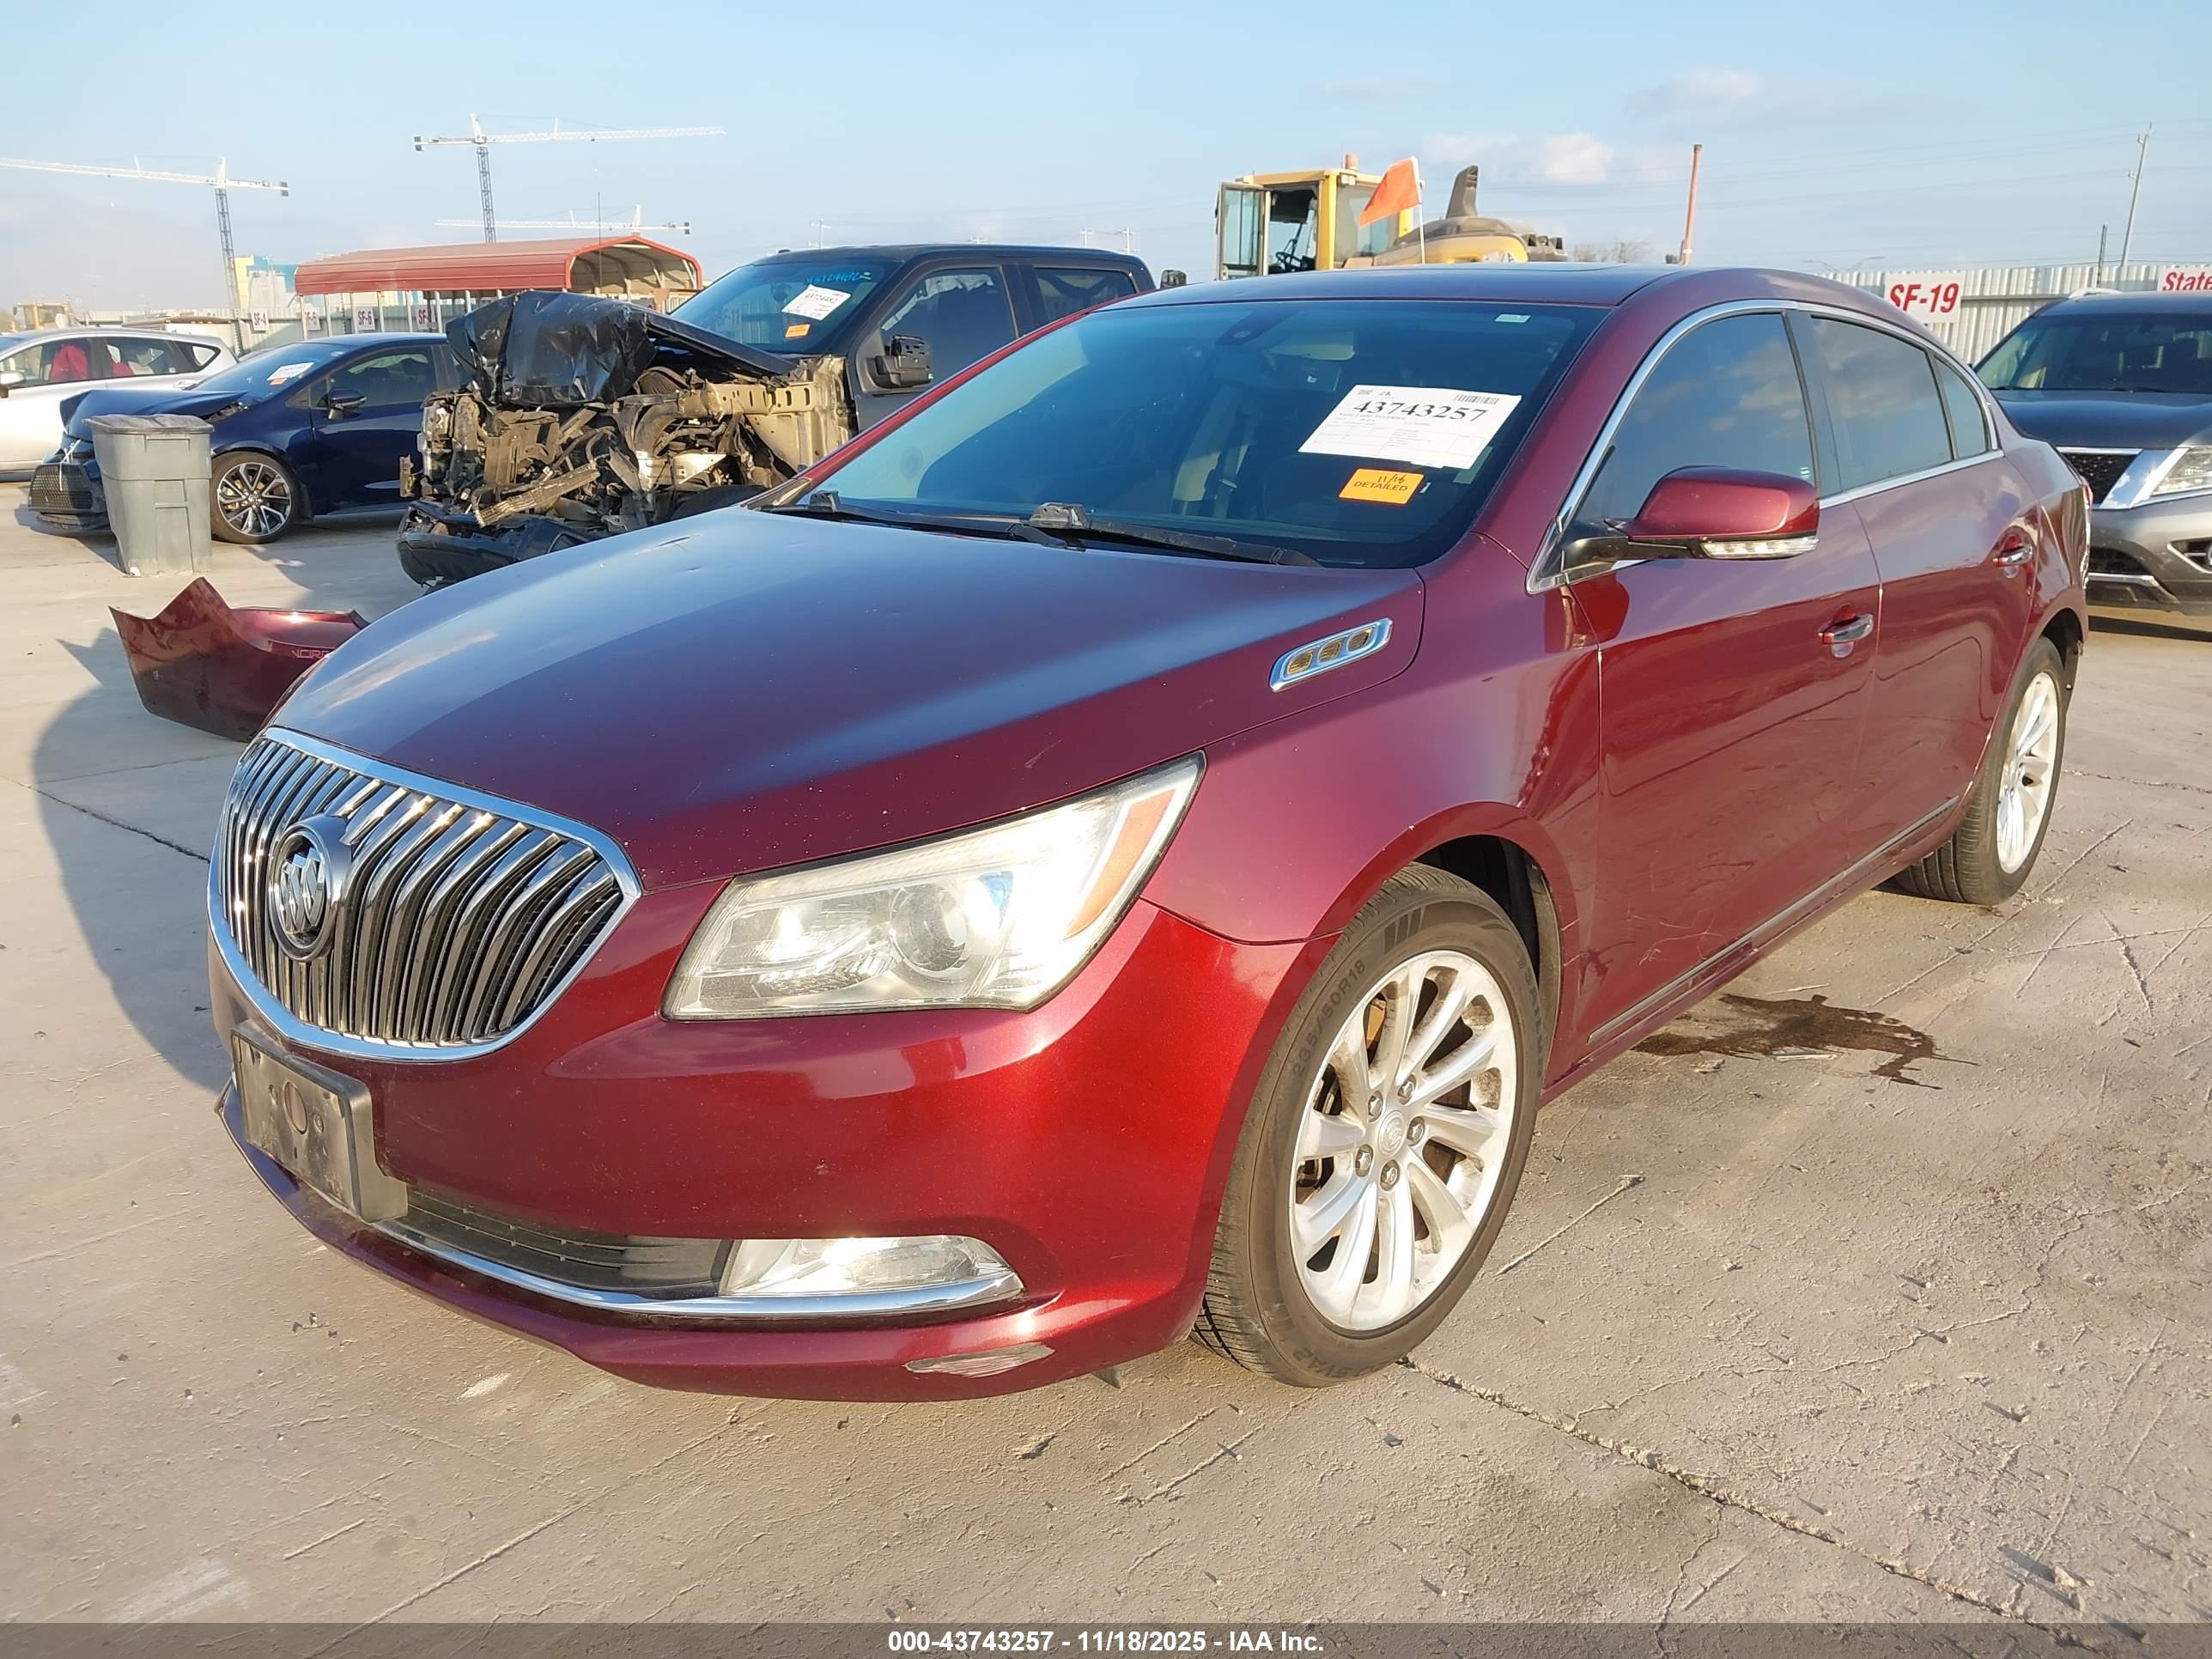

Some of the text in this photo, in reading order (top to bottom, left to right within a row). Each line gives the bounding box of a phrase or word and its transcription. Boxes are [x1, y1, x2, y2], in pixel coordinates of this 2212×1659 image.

[2162, 271, 2212, 291] State
[1890, 283, 1960, 313] SF-19
[253, 312, 266, 325] SF-4
[357, 310, 372, 325] SF-6
[1353, 401, 1488, 422] 43743257
[1353, 481, 1408, 492] DETAILED
[1292, 959, 1366, 1077] 235/50R18
